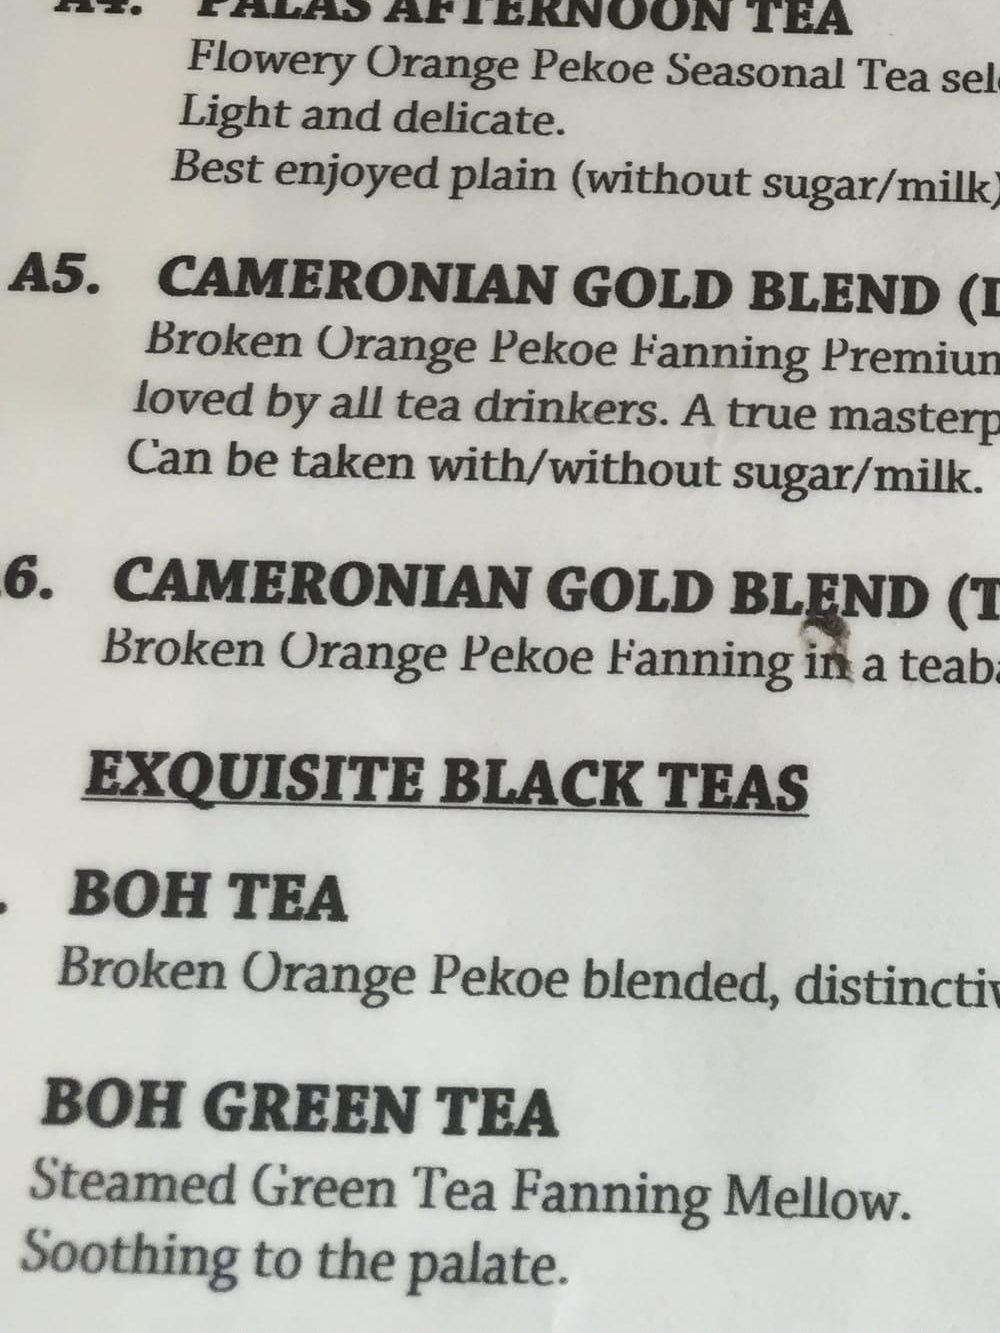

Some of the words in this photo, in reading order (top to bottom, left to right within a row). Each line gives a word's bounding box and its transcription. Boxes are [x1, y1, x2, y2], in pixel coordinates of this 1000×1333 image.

[186, 38, 358, 87] Flowery
[366, 44, 520, 91] Orange
[530, 48, 655, 85] Pekoe
[666, 52, 846, 90] Seasonal
[856, 57, 931, 93] Tea
[7, 251, 100, 295] A5.
[157, 254, 560, 306] CAMERONIAN
[572, 265, 734, 310] GOLD
[748, 269, 941, 316] BLEND
[144, 320, 303, 359] Broken
[317, 324, 478, 375] Orange
[489, 329, 618, 367] Pekoe
[630, 332, 811, 384] Fanning
[132, 378, 254, 417] loved
[266, 382, 322, 430] by
[328, 385, 383, 420] all
[396, 389, 462, 422] tea
[474, 388, 669, 427] drinkers.
[680, 393, 716, 427] A
[727, 397, 817, 431] true
[112, 555, 533, 610] CAMERONIAN
[546, 565, 715, 614] GOLD
[729, 570, 930, 619] BLEND
[100, 626, 265, 668] Broken
[280, 631, 448, 685] Orange
[459, 634, 594, 675] Pekoe
[606, 638, 795, 693] Fanning
[804, 640, 851, 681] in
[861, 653, 888, 683] a
[84, 749, 425, 810] EXQUISITE
[440, 756, 646, 808] BLACK
[657, 761, 811, 813] TEAS
[67, 868, 212, 919] BOH
[227, 872, 349, 923] TEA
[57, 945, 227, 991] Broken
[242, 950, 417, 1009] Orange
[429, 953, 570, 999] Pekoe
[583, 957, 780, 1011] blended,
[40, 1076, 187, 1130] BOH
[202, 1080, 422, 1135] GREEN
[435, 1086, 560, 1139] TEA
[29, 1156, 236, 1206] Steamed
[252, 1163, 397, 1209] Green
[412, 1166, 497, 1212] Tea
[511, 1168, 713, 1232] Fanning
[723, 1173, 911, 1222] Mellow.
